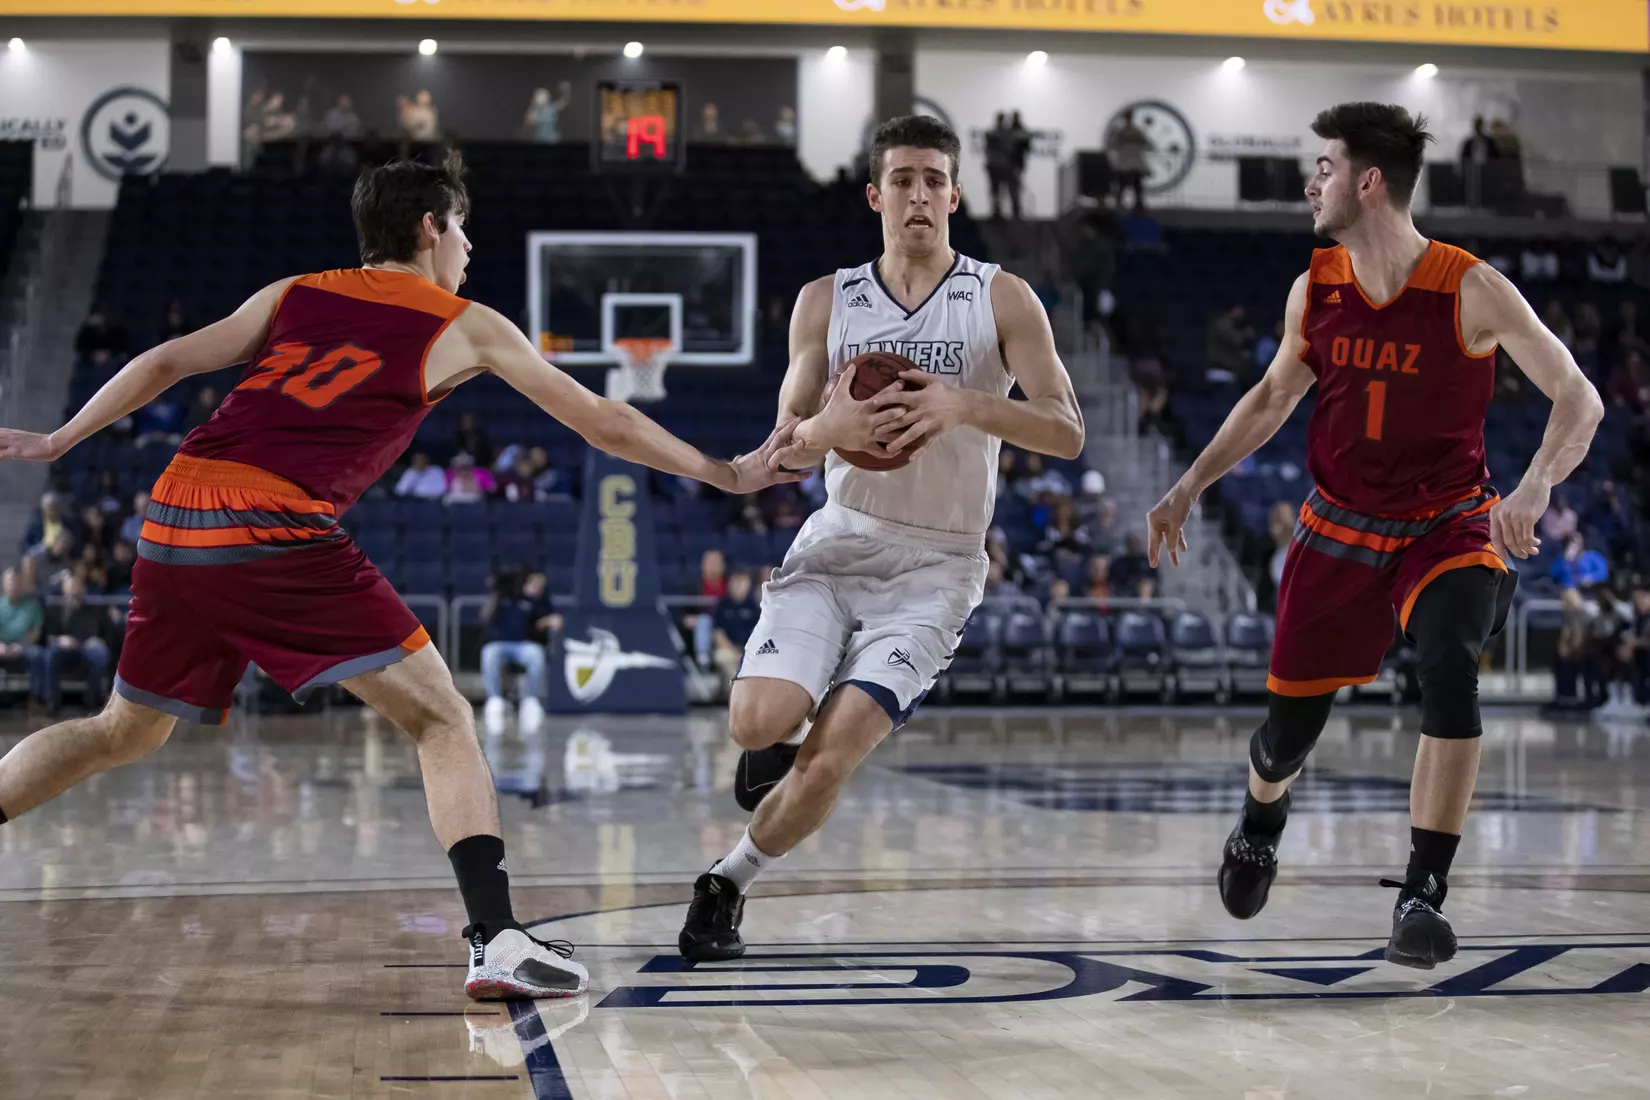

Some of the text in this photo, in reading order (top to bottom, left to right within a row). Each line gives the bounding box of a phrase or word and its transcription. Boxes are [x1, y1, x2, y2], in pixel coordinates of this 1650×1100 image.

[626, 114, 666, 159] 19
[848, 301, 872, 309] adidas
[948, 291, 973, 302] WAC
[1331, 336, 1421, 374] OUAZ
[1364, 380, 1387, 441] 1
